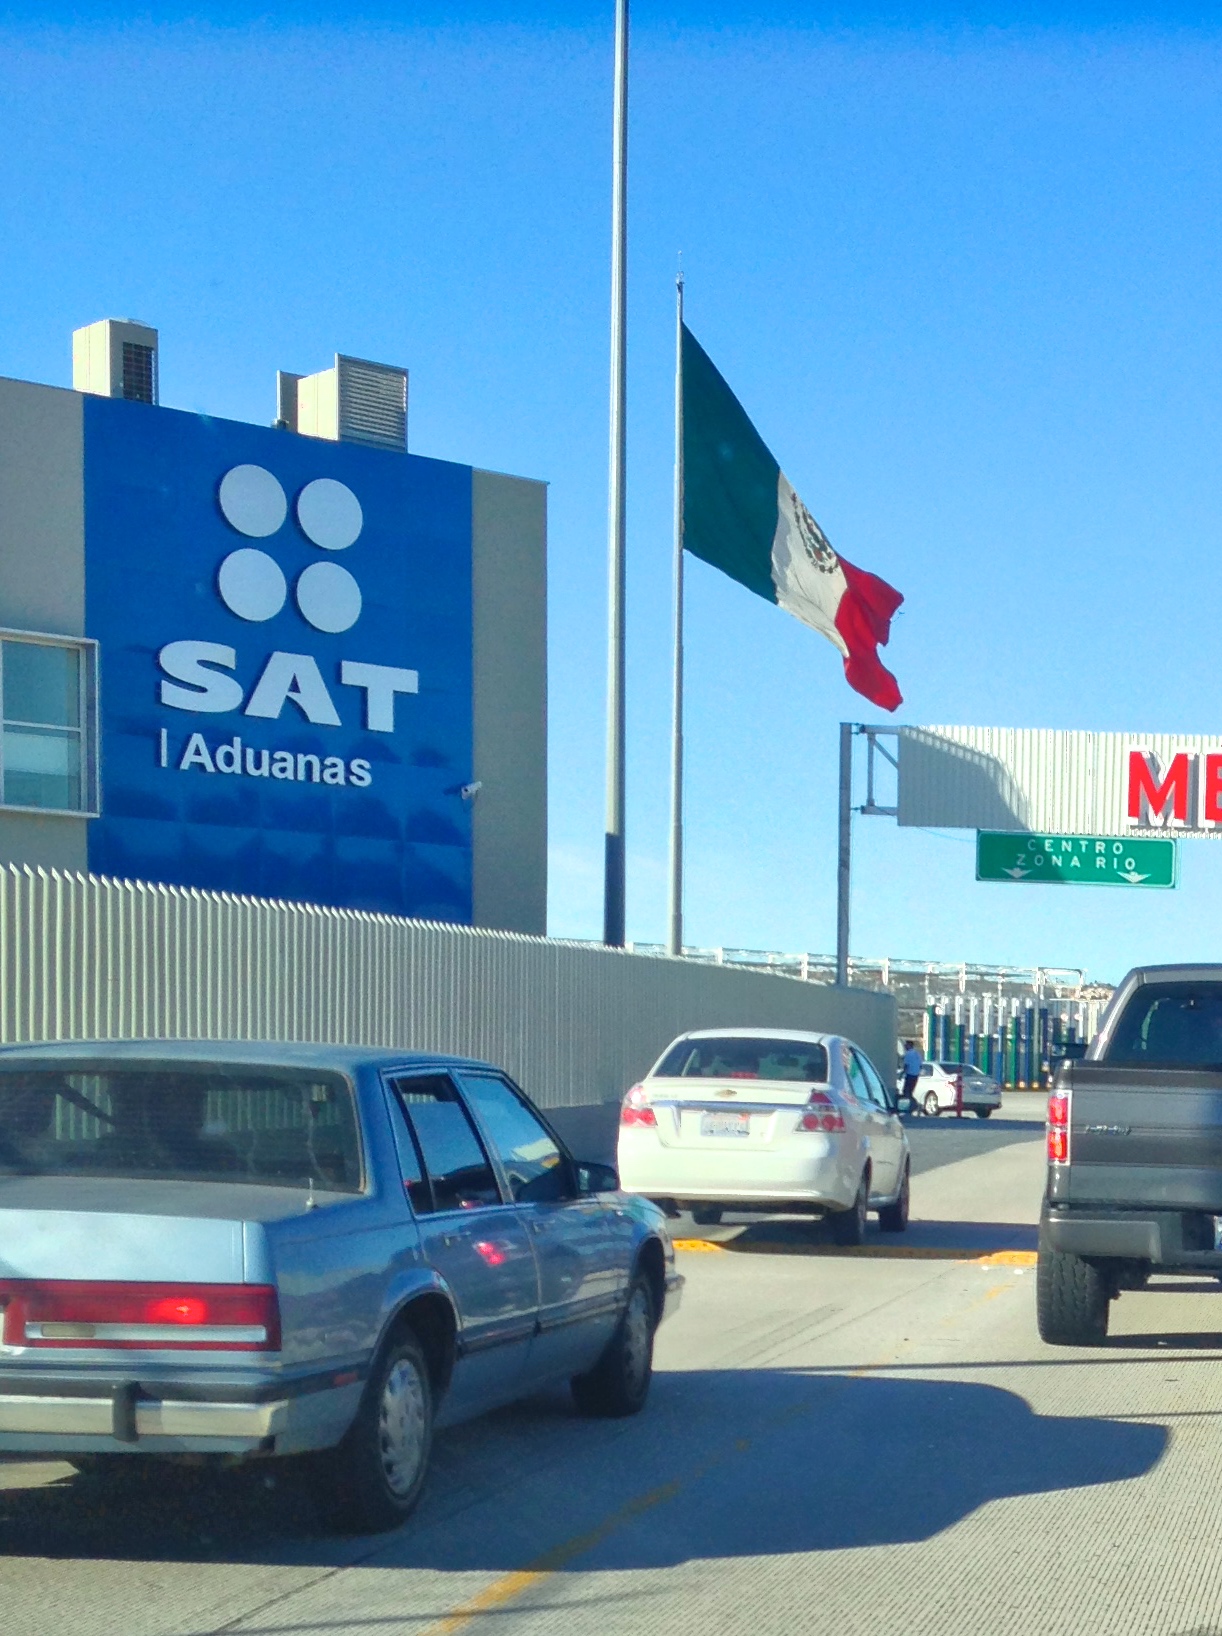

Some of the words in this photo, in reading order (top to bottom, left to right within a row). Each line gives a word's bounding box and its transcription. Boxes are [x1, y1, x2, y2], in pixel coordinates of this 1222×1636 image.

[159, 639, 419, 733] SAT
[180, 732, 373, 788] Aduanas
[1016, 853, 1081, 868] ZONA
[1096, 857, 1136, 871] RIO
[1027, 839, 1124, 854] CENTRO
